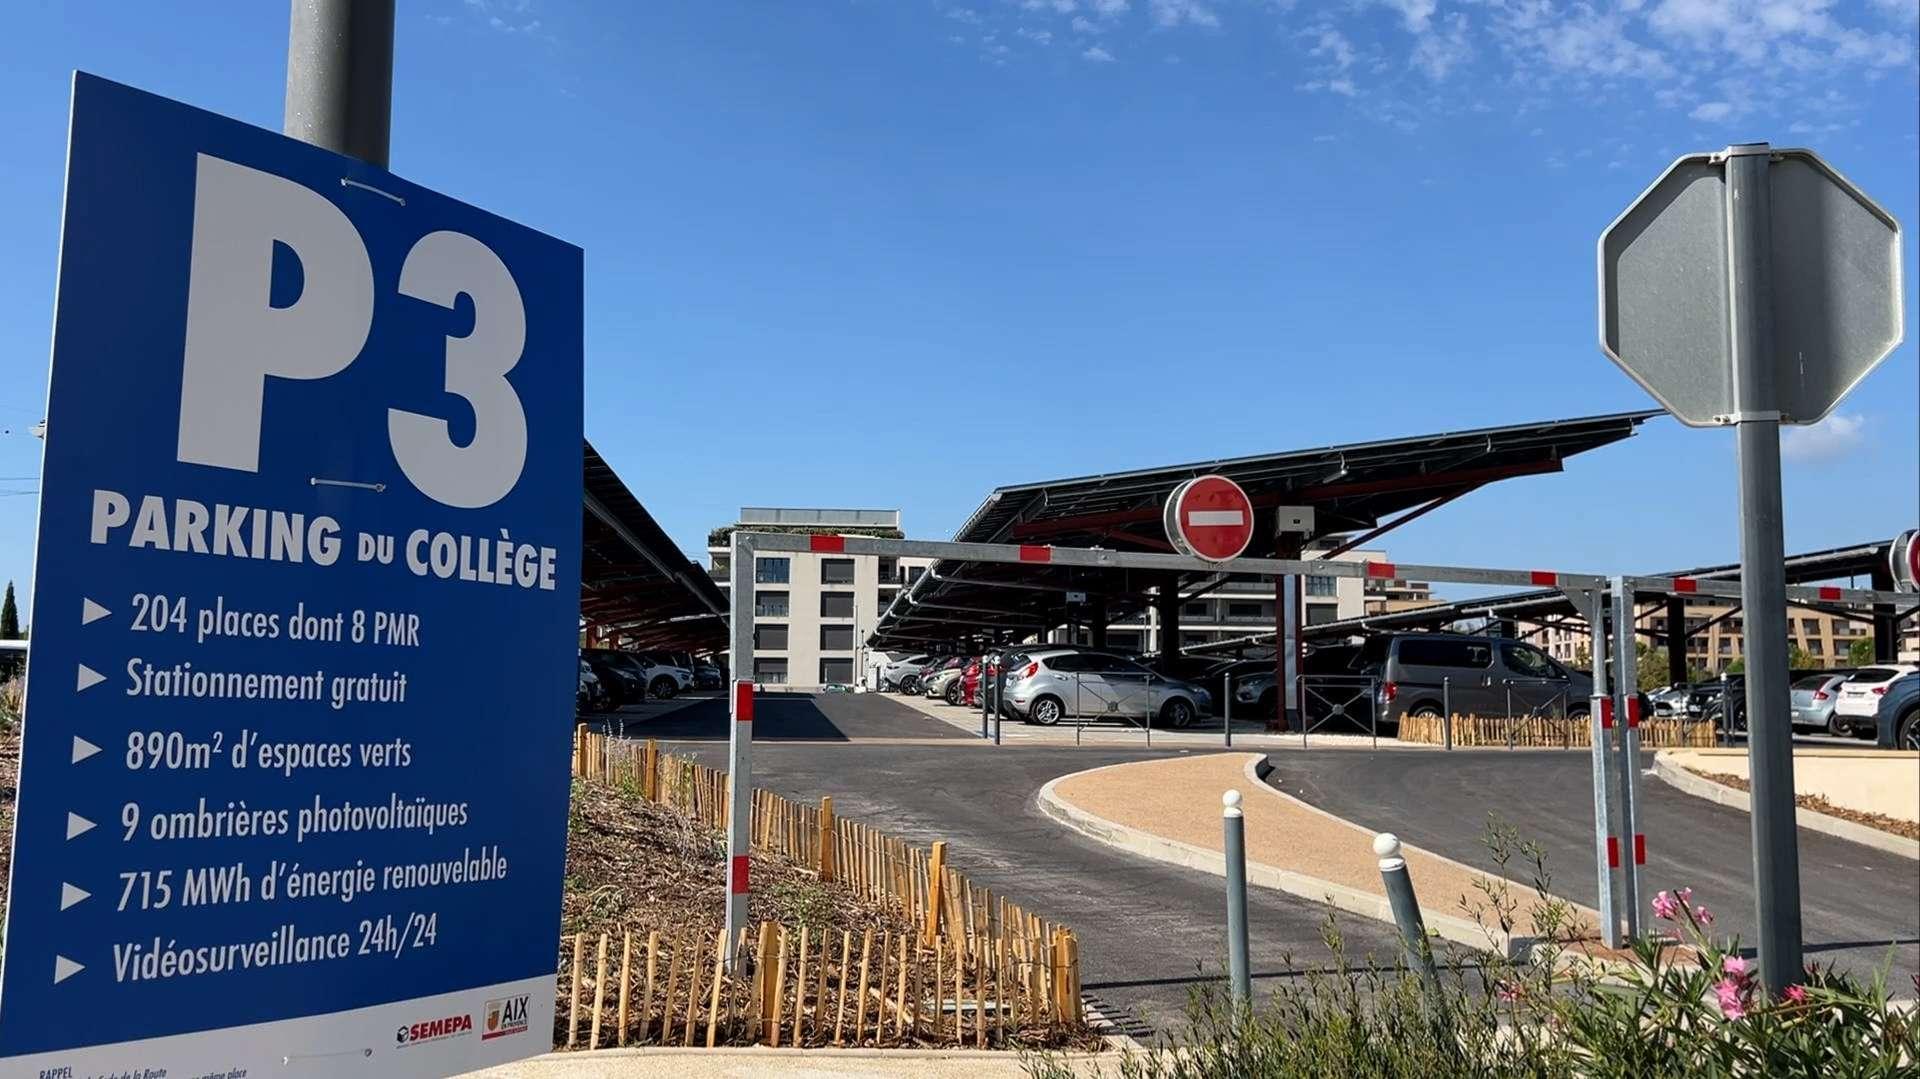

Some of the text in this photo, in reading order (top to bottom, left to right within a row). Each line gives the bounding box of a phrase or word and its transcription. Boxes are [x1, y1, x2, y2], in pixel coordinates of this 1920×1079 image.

[177, 153, 527, 508] P3
[90, 489, 557, 591] PARKING DU COLLÈGE
[130, 593, 420, 647] 204 places dont 8 PMR
[126, 657, 407, 709] Stationnement gratuit
[231, 729, 352, 777] d'espaces
[359, 738, 411, 767] verts
[121, 793, 468, 843] 9 ombrières photovoltaïques
[117, 845, 507, 912] 715 MWh d'énergie renouvelable
[113, 911, 437, 983] Vidéosurveillance 24h/24
[409, 1014, 472, 1041] SEMEPA
[502, 996, 529, 1024] AIX
[39, 1066, 73, 1079] RAPPEL
